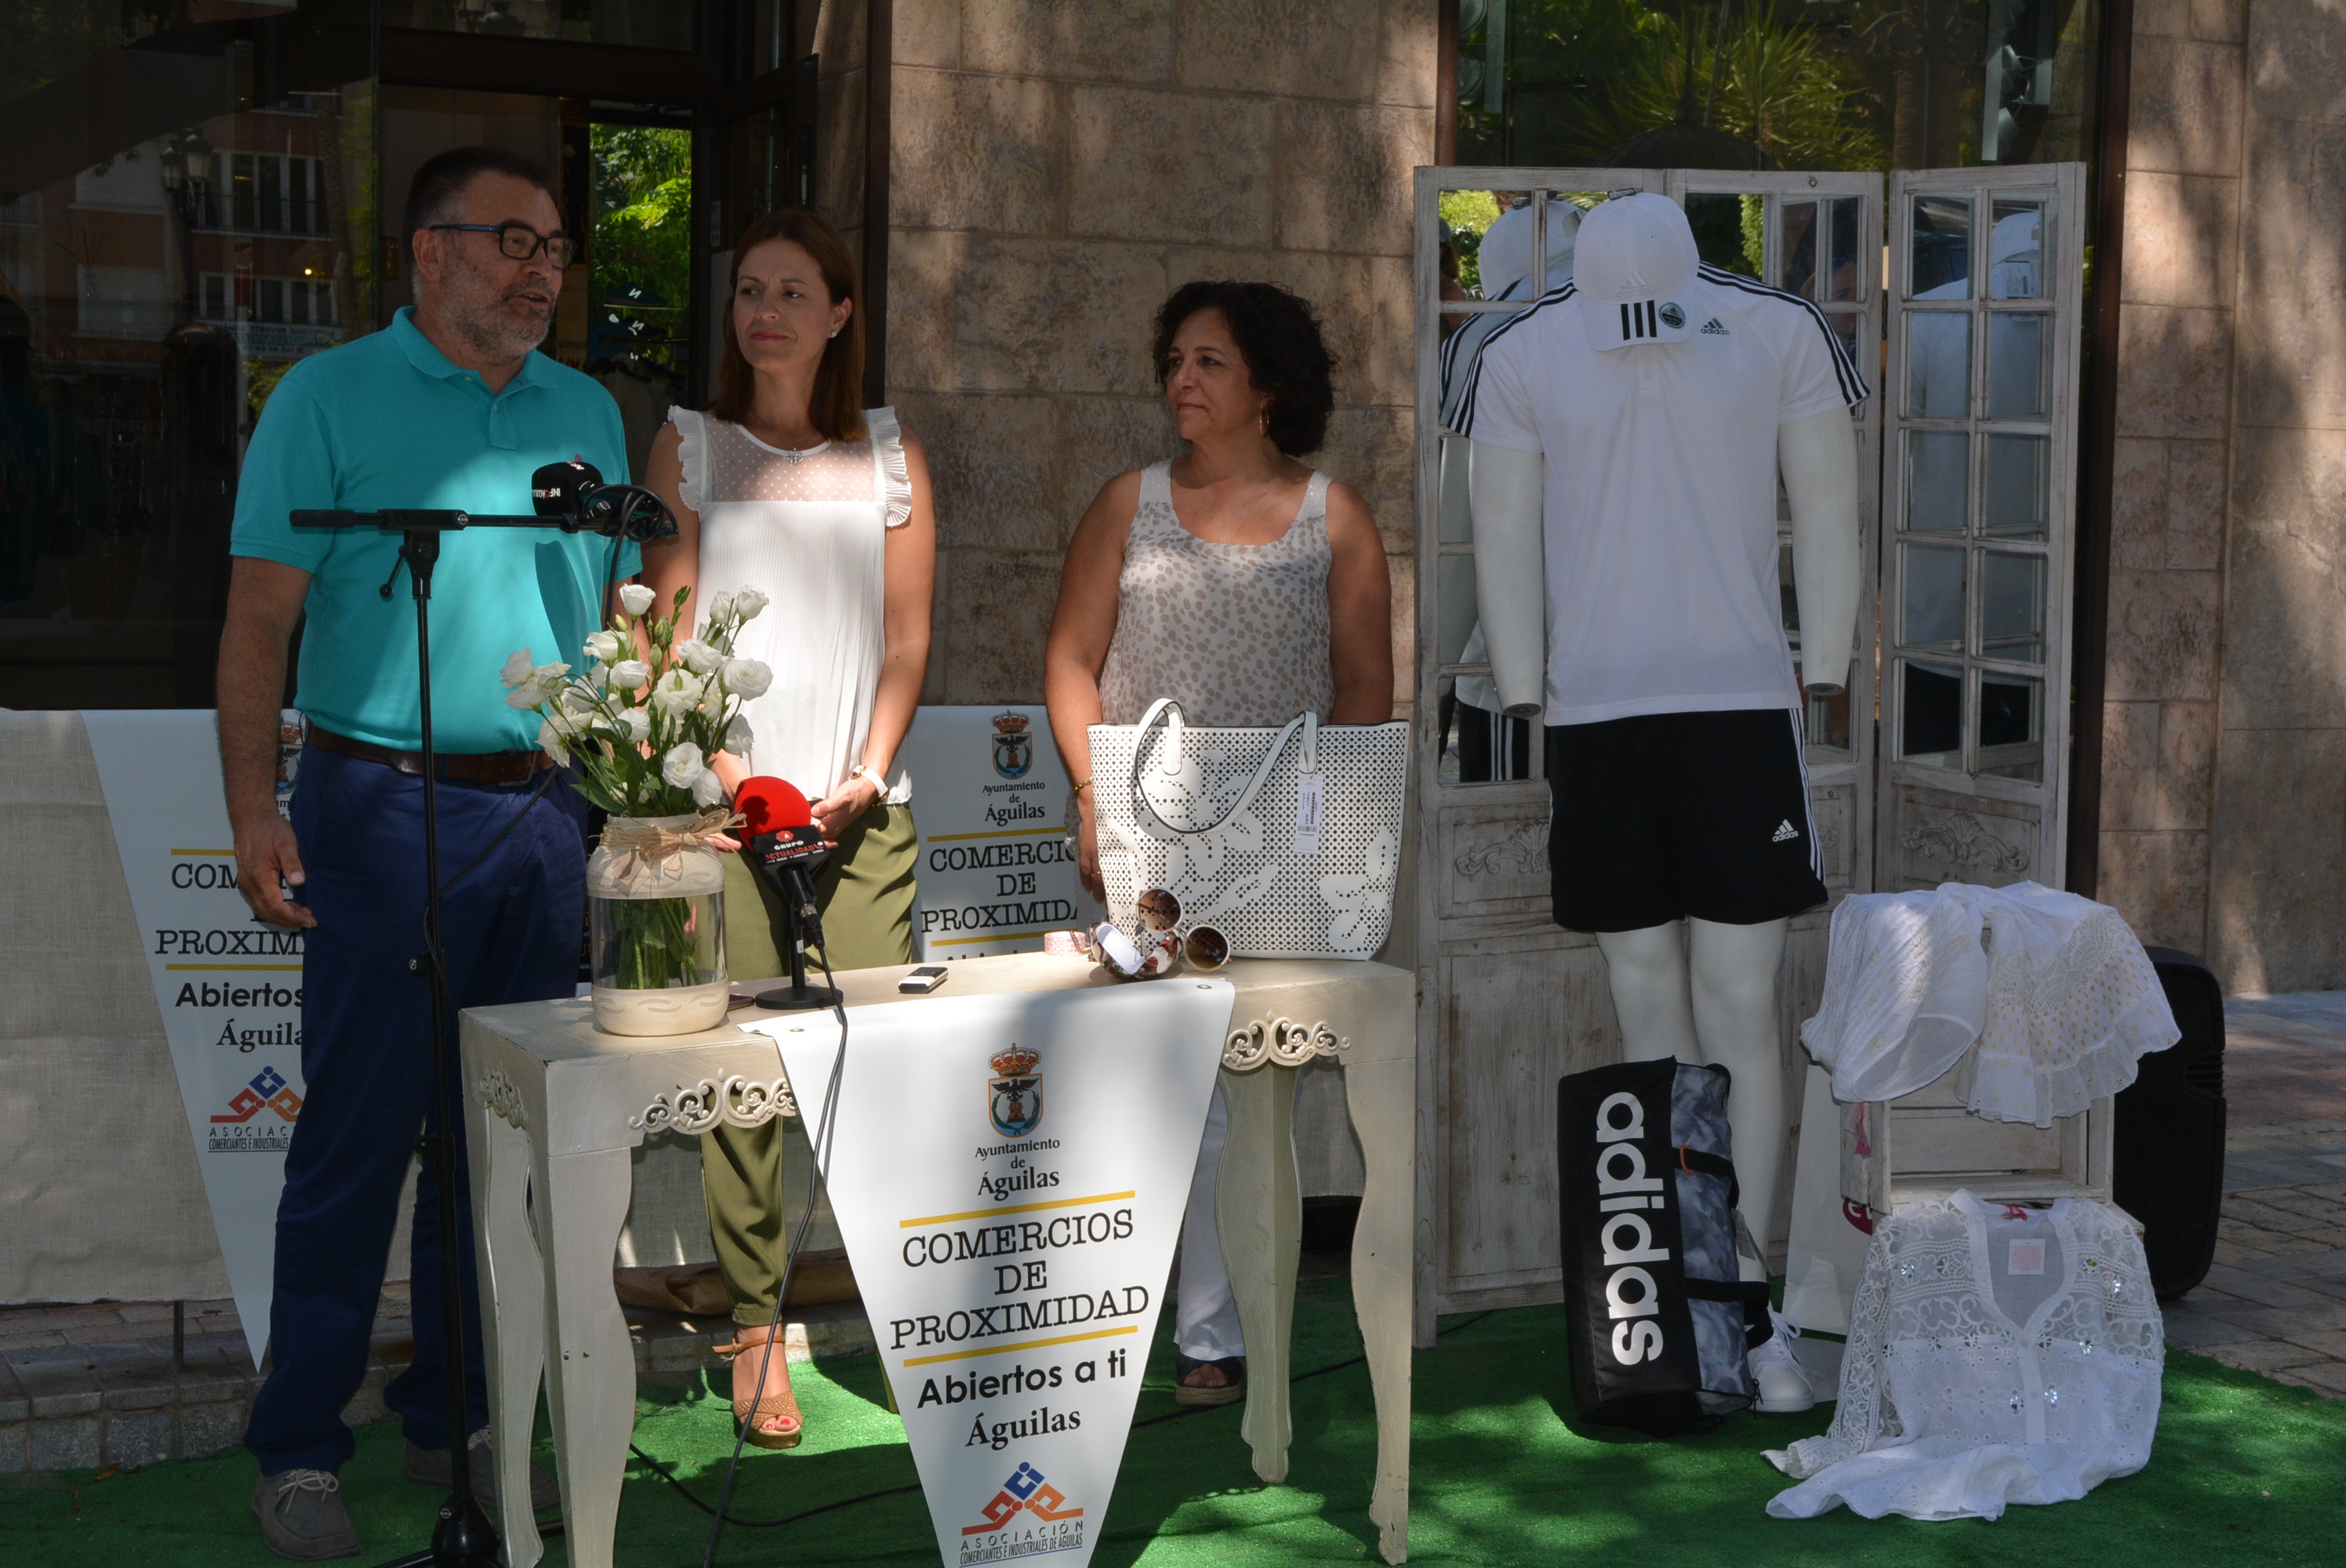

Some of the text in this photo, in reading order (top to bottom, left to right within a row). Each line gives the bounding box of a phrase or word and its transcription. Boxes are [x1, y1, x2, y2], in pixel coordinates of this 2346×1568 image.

[1701, 326, 1730, 336] adidas
[982, 782, 1045, 796] Ayuntamiento
[1009, 793, 1020, 804] de
[985, 802, 1045, 826] Águilas
[1772, 830, 1799, 843] adidas
[929, 840, 1076, 872] COMERCI
[997, 872, 1036, 897] DE
[921, 899, 1077, 933] PROXIMID
[155, 930, 304, 955] PROXIM
[209, 1126, 295, 1138] ASOCIAC
[209, 1137, 289, 1150] COMERCIANTES E INDUSTRIALES
[975, 1138, 1060, 1161] Ayuntamiento
[1011, 1156, 1026, 1169] de
[977, 1166, 1059, 1201] Águilas
[902, 1208, 1134, 1268] COMERCIOS
[1596, 1091, 1672, 1367] adidas
[994, 1260, 1048, 1295] DE
[890, 1286, 1149, 1350] PROXIMIDAD
[917, 1348, 1126, 1409] Abiertos a ti
[964, 1406, 1081, 1451] Águilas
[960, 1532, 1083, 1565] COMERCIANTES E INDUSTRIALES DE ÁGUILAS
[961, 1519, 1083, 1552] ASOCIACIÓN
